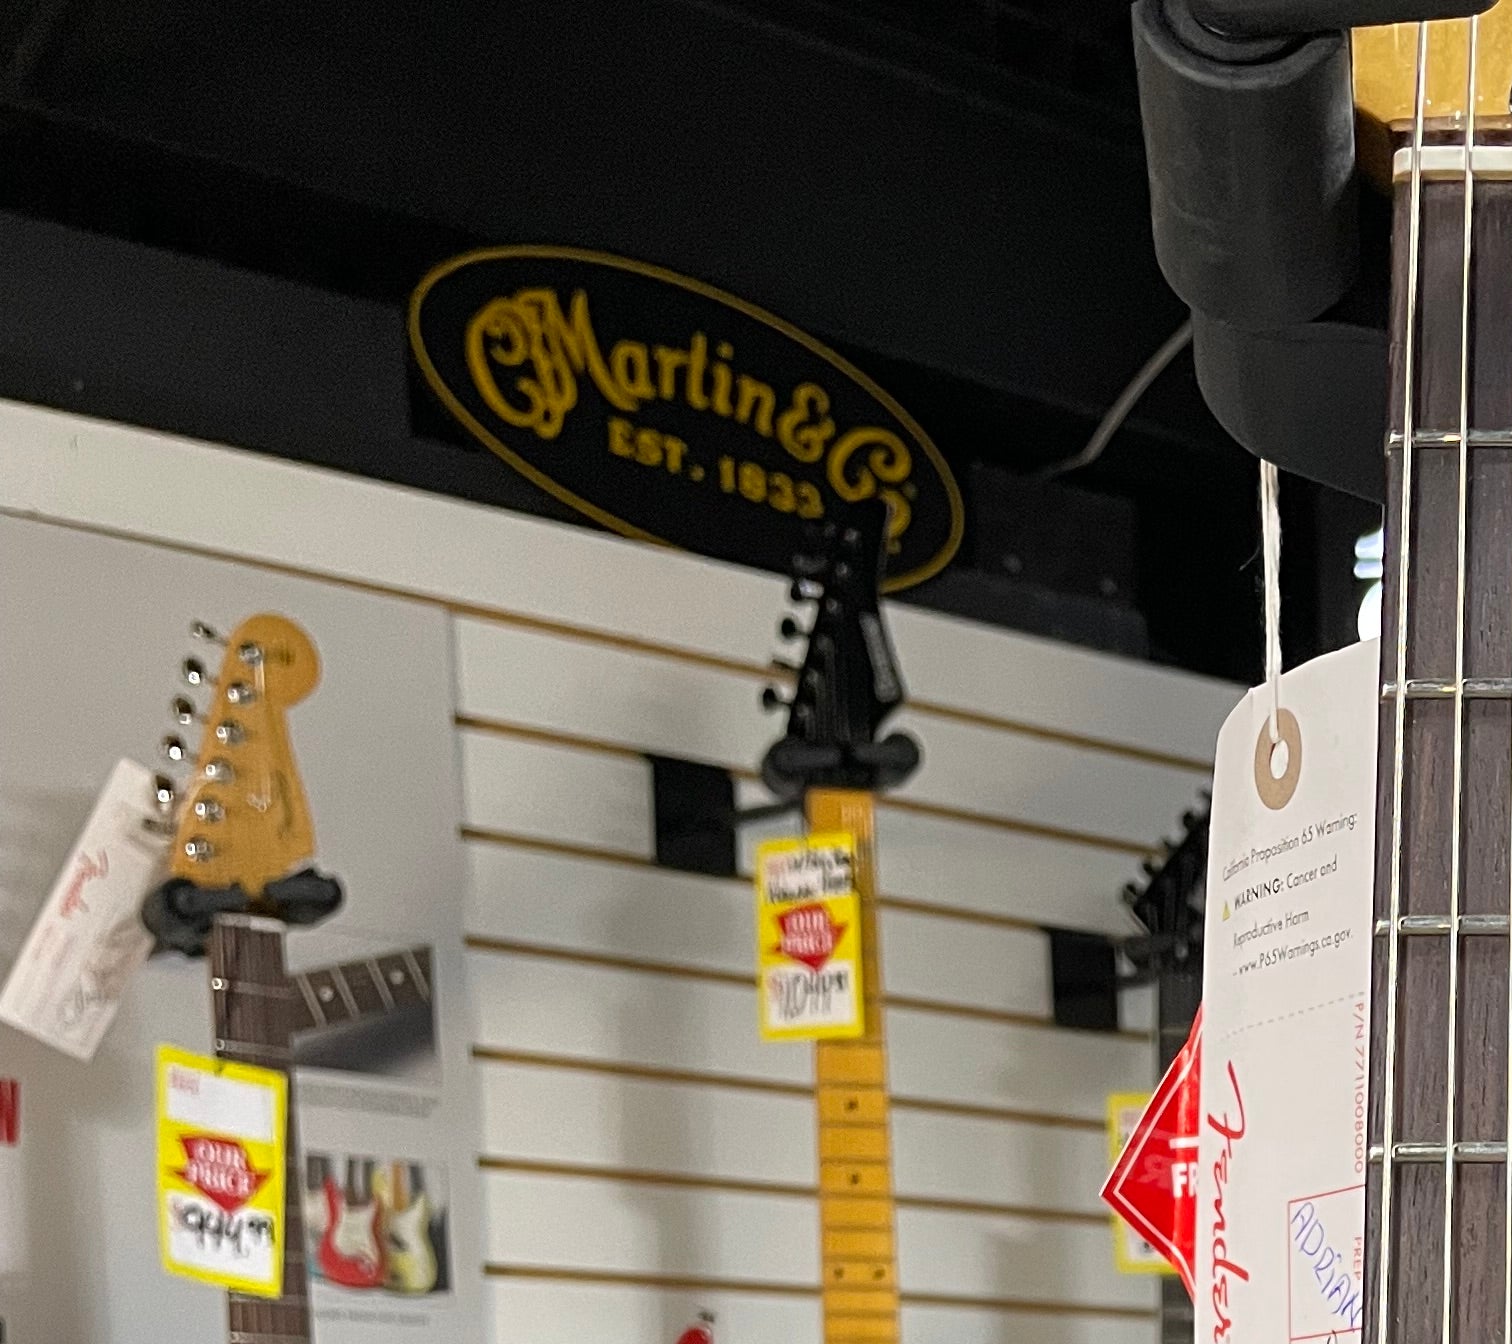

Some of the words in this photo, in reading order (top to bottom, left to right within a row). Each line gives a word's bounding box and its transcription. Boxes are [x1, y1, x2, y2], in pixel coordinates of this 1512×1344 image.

[1250, 836, 1300, 864] Proposition
[1301, 825, 1314, 846] 65
[1315, 812, 1358, 839] Warning:
[1234, 877, 1284, 911] WARNING:
[1286, 867, 1318, 890] Cancer
[1320, 854, 1338, 877] and
[1285, 909, 1310, 929] Harm
[1353, 1002, 1365, 1040] P/N
[1354, 1045, 1366, 1174] 7711008000
[1207, 1059, 1250, 1344] Fender
[1353, 1235, 1364, 1282] PREP
